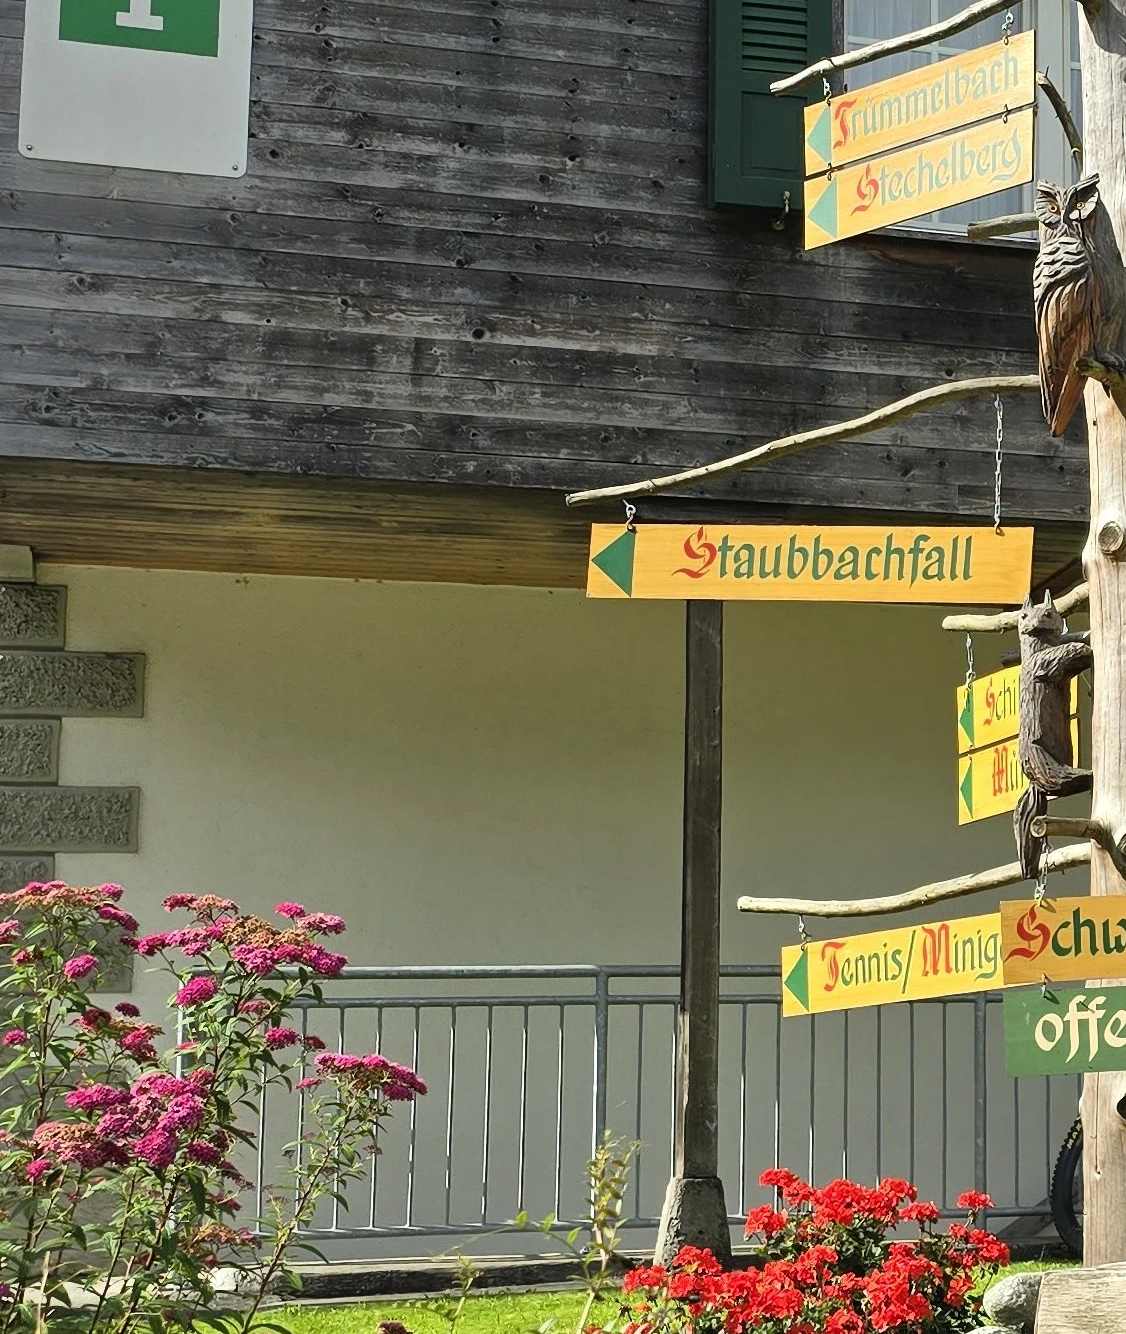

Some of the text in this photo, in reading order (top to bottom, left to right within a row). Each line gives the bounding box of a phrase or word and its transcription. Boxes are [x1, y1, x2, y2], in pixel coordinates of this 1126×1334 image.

[833, 49, 1019, 150] Trümmelbach
[850, 127, 1022, 217] Stechelberg
[671, 525, 973, 589] Staubbachfall
